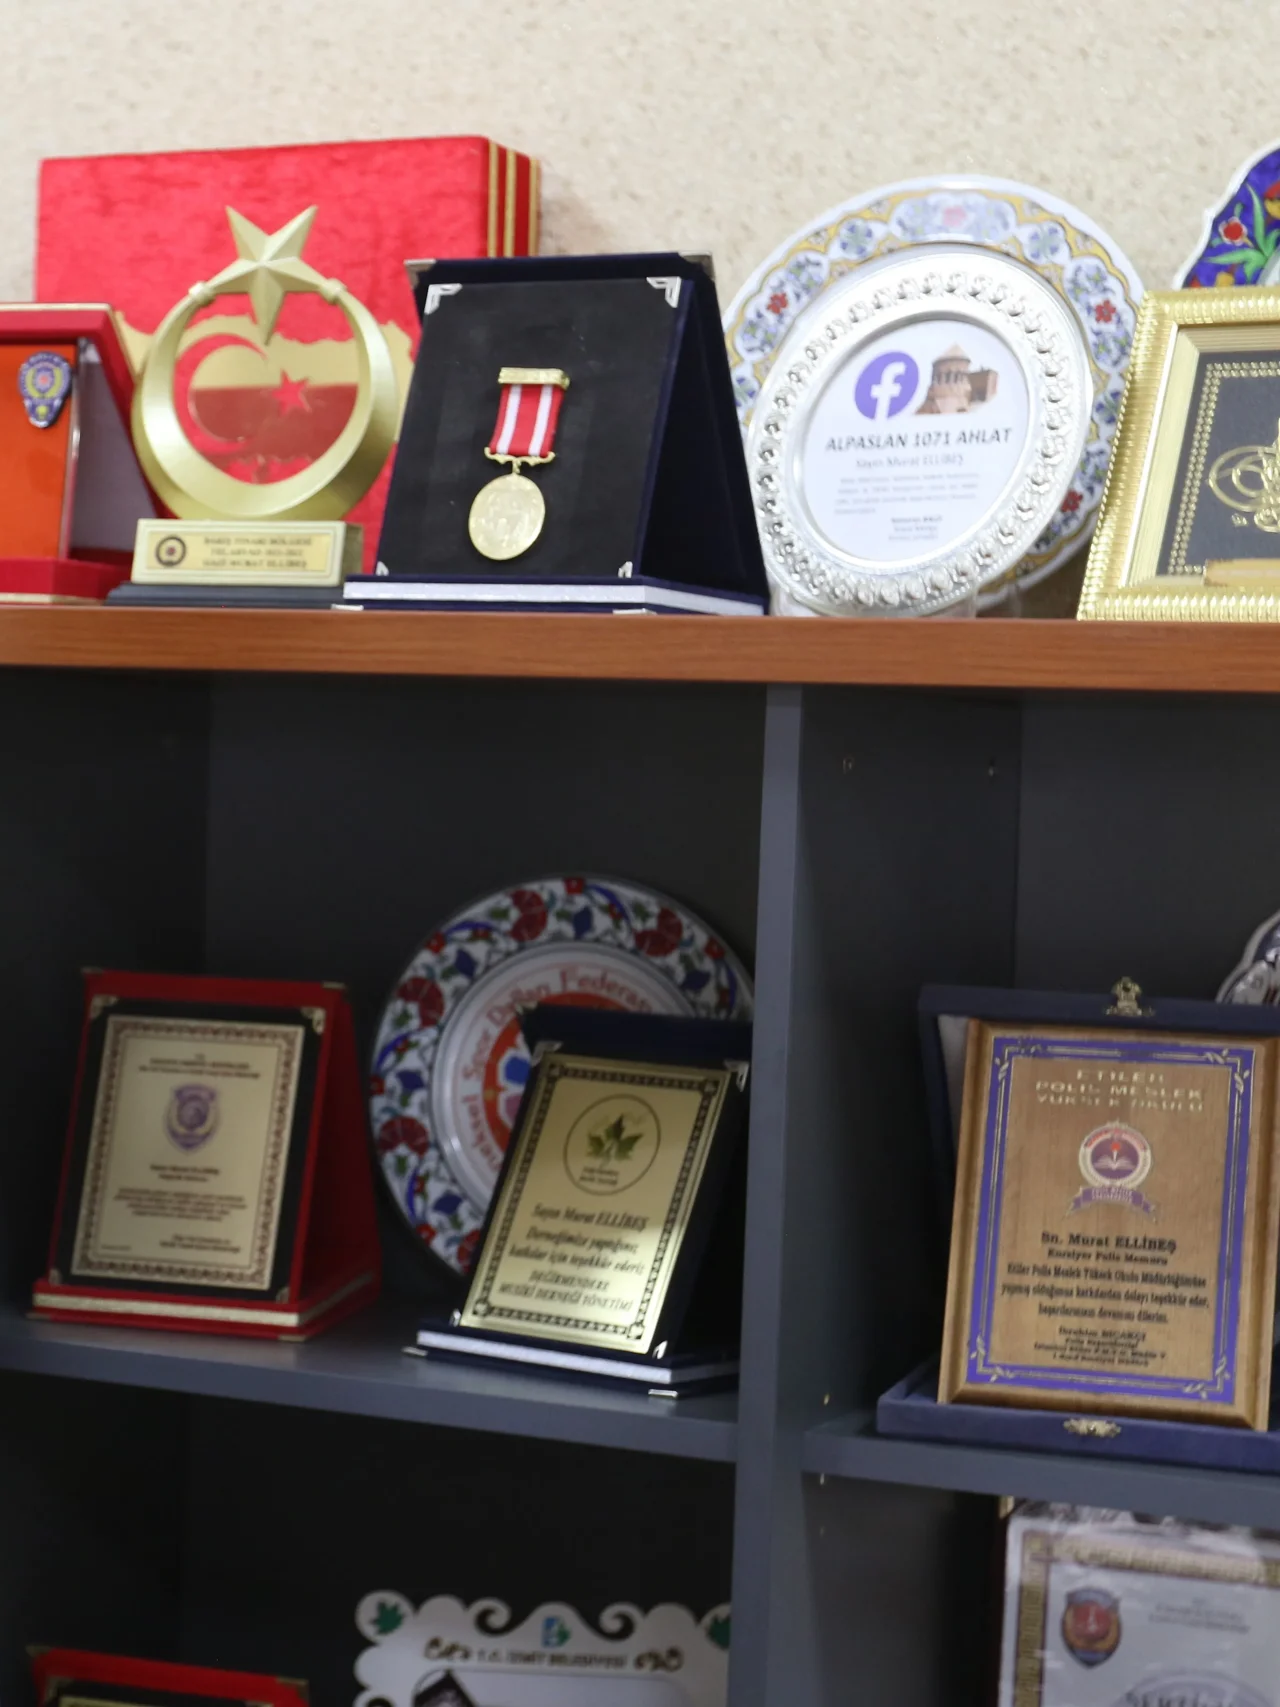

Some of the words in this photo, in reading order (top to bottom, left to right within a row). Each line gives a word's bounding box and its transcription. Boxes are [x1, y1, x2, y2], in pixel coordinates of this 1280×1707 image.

[825, 433, 908, 452] ALPASLAN
[913, 431, 949, 447] 1071
[956, 427, 1013, 445] AHLAT
